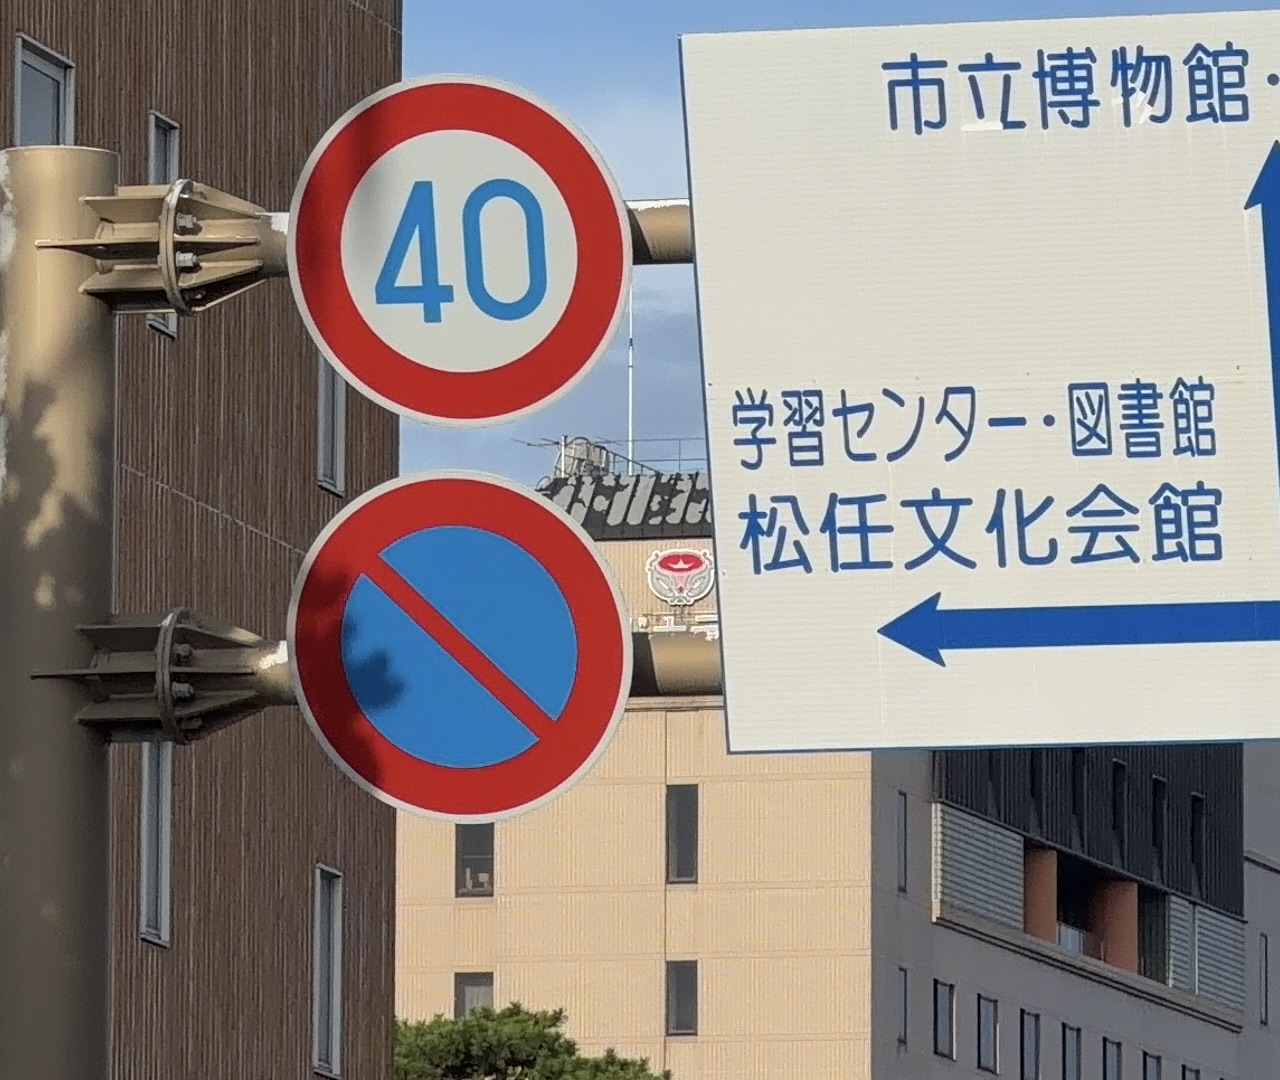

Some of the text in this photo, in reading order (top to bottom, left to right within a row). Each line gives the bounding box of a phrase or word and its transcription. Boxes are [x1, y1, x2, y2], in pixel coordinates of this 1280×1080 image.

[375, 178, 548, 324] 40
[731, 376, 1218, 470] 学習センター・図書館
[738, 481, 1224, 575] 松任文化会館
